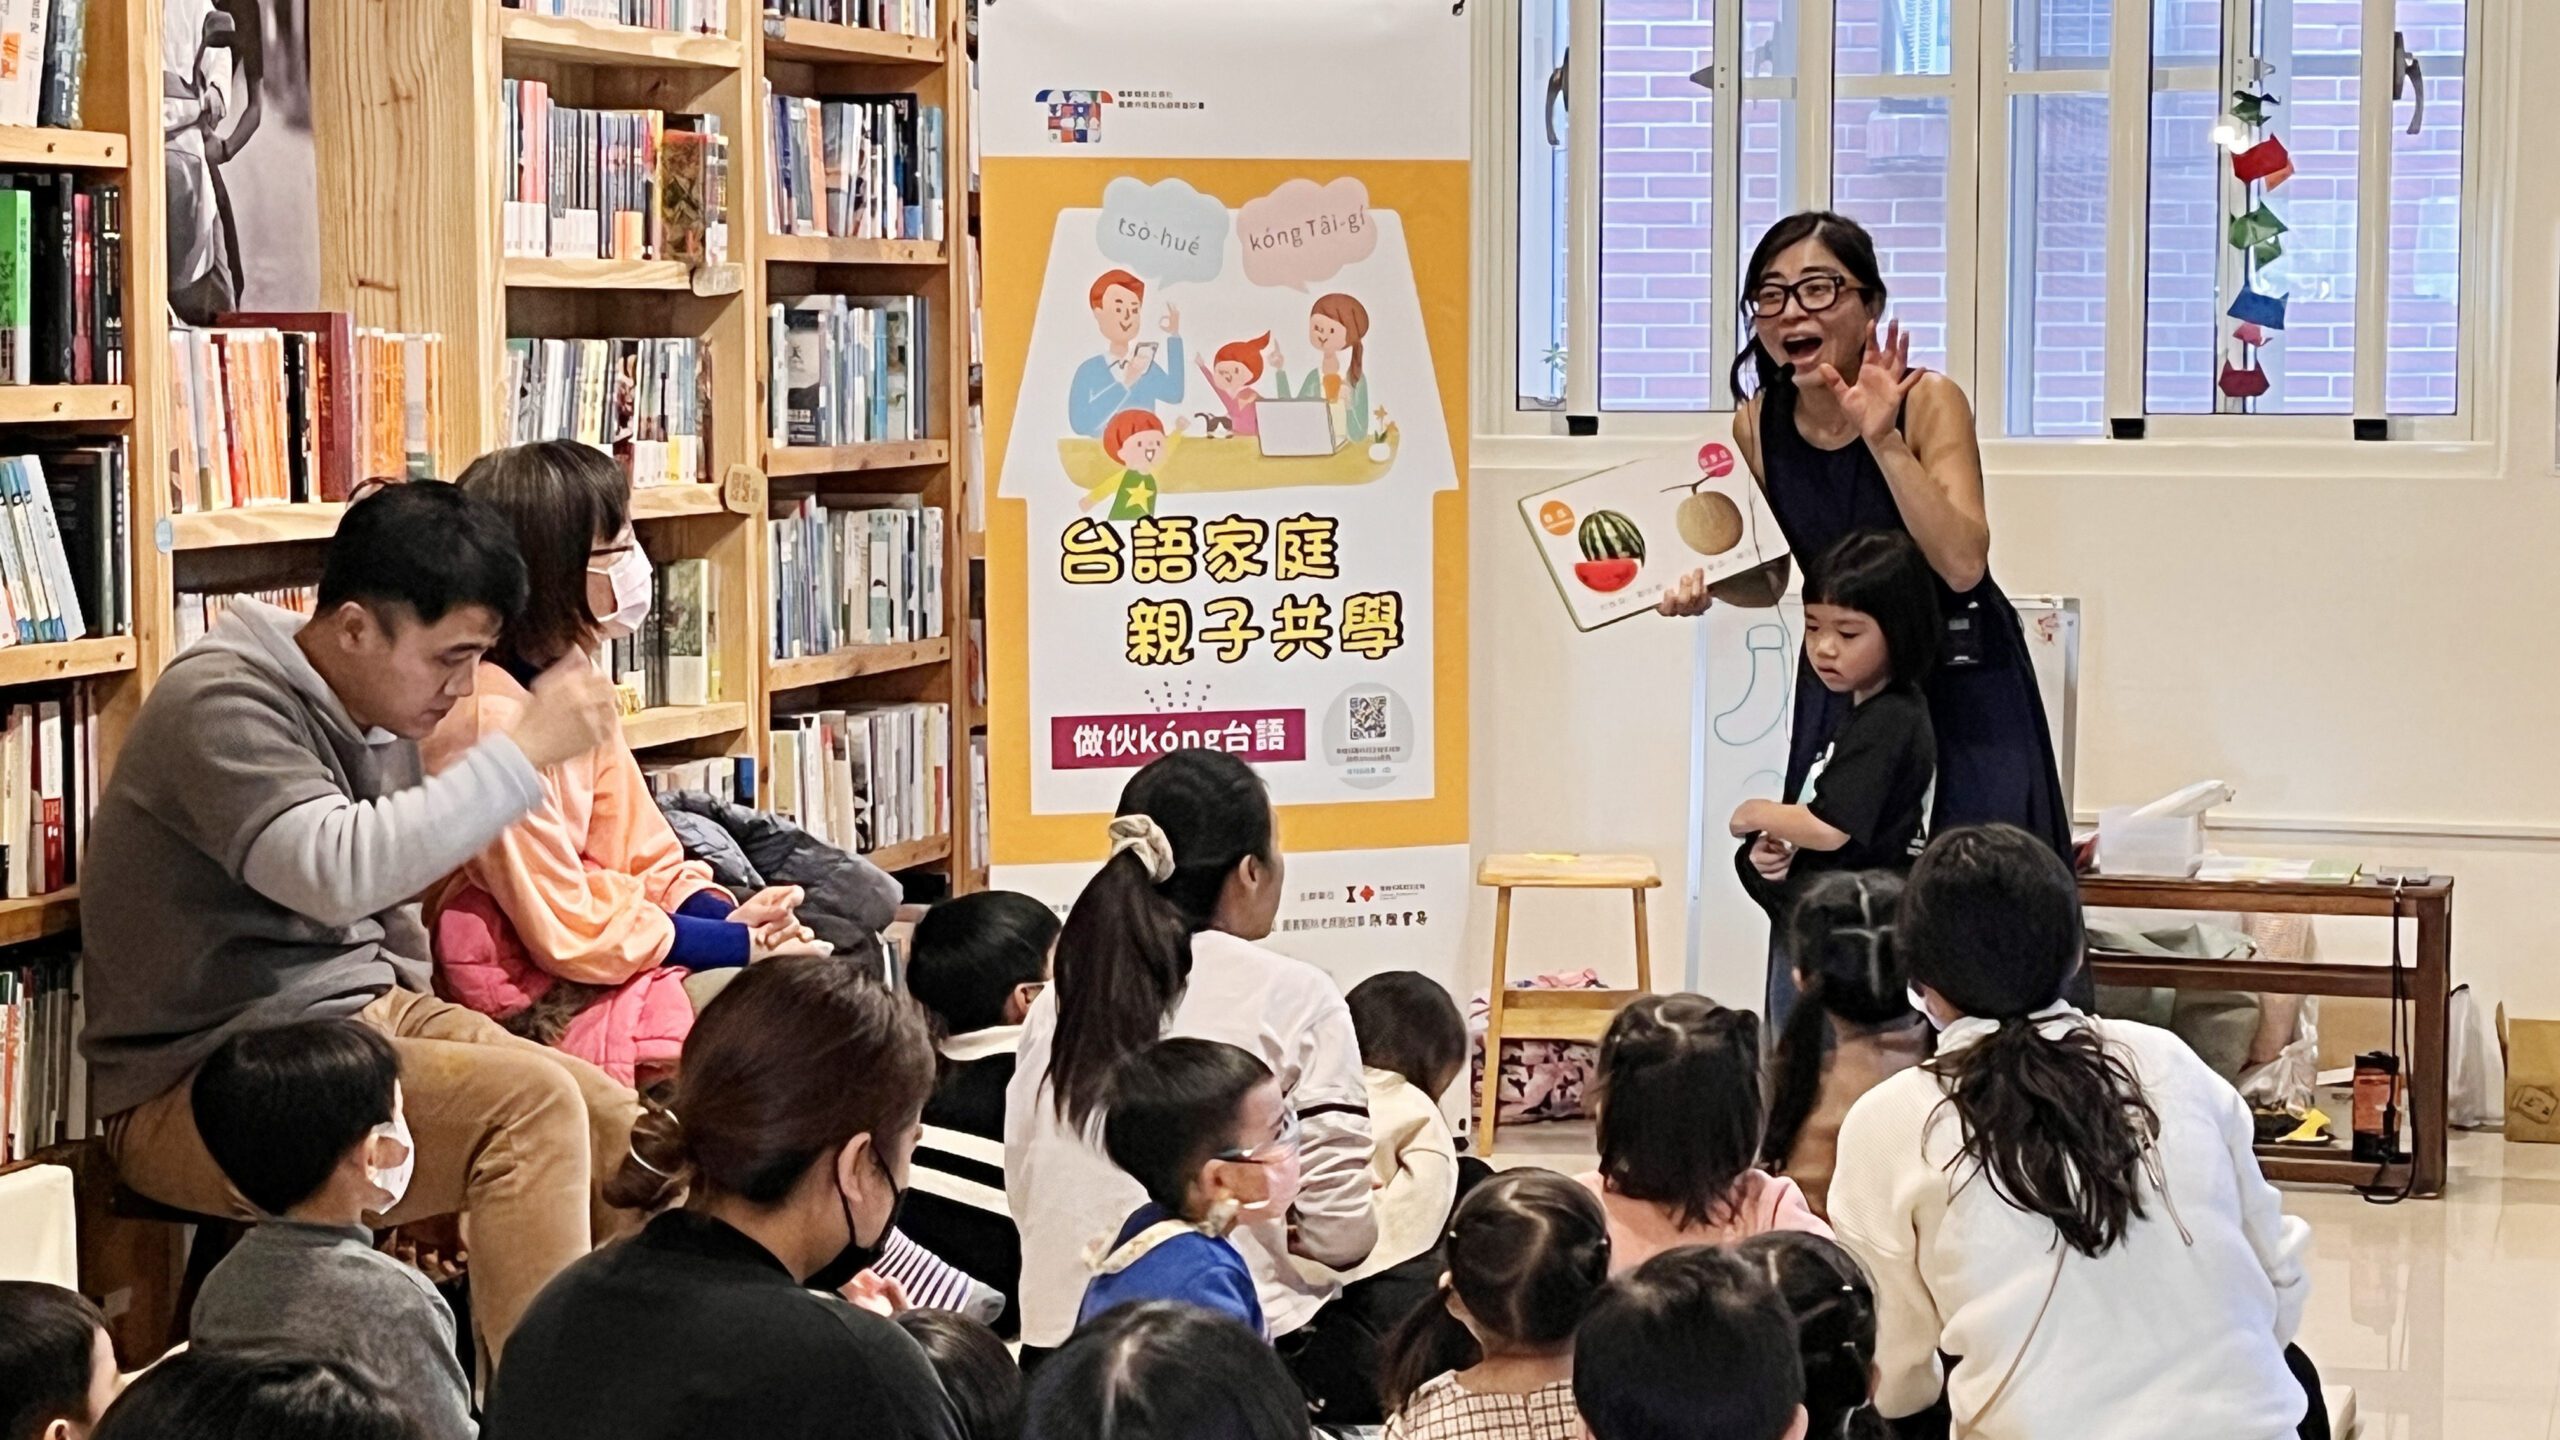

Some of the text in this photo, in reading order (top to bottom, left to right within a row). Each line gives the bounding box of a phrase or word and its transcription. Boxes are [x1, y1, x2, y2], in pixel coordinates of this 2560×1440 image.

[1249, 227, 1303, 251] kóng
[1060, 512, 1340, 585] 台語家庭
[1126, 590, 1405, 666] 親子共學
